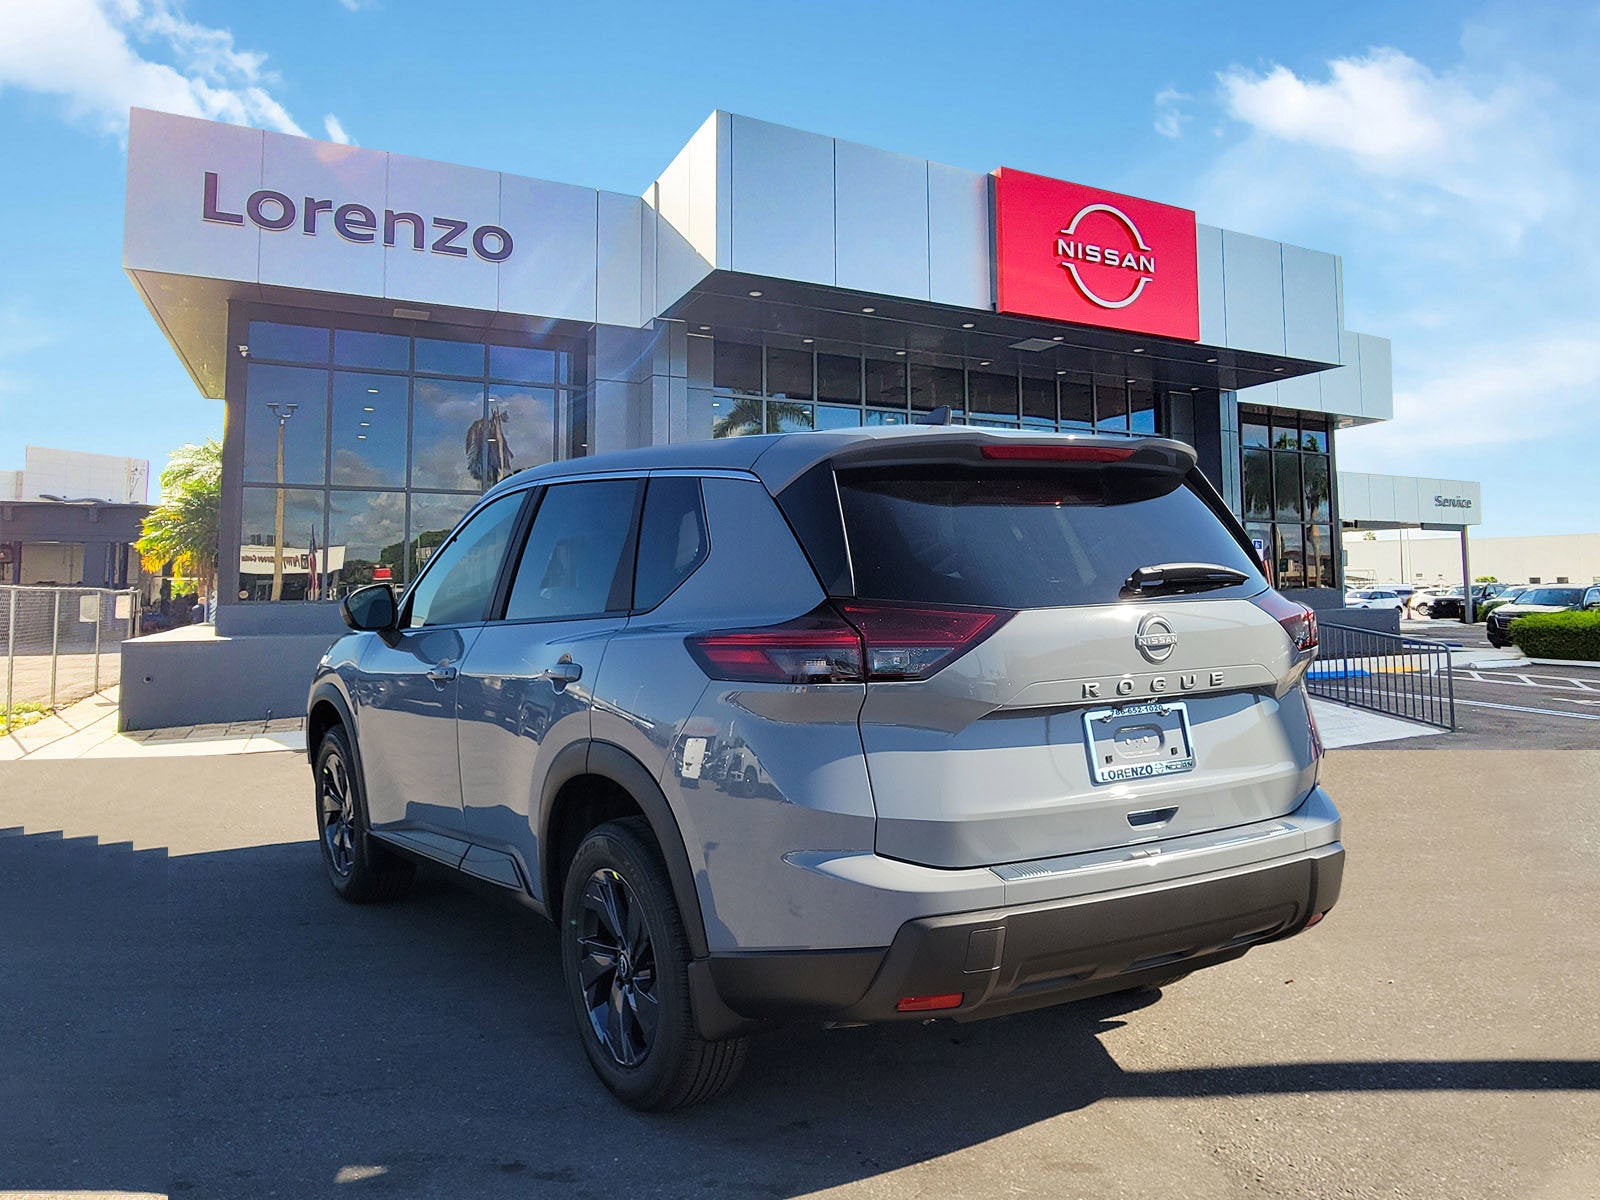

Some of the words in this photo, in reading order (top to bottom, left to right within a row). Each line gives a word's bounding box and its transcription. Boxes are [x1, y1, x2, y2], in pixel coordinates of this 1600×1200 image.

[202, 171, 514, 262] Lorenzo
[1057, 238, 1155, 273] NISSAN
[1434, 495, 1472, 508] Service
[1138, 634, 1177, 645] NISSAN
[1082, 672, 1224, 698] ROGUE
[1101, 764, 1153, 781] LORENZO
